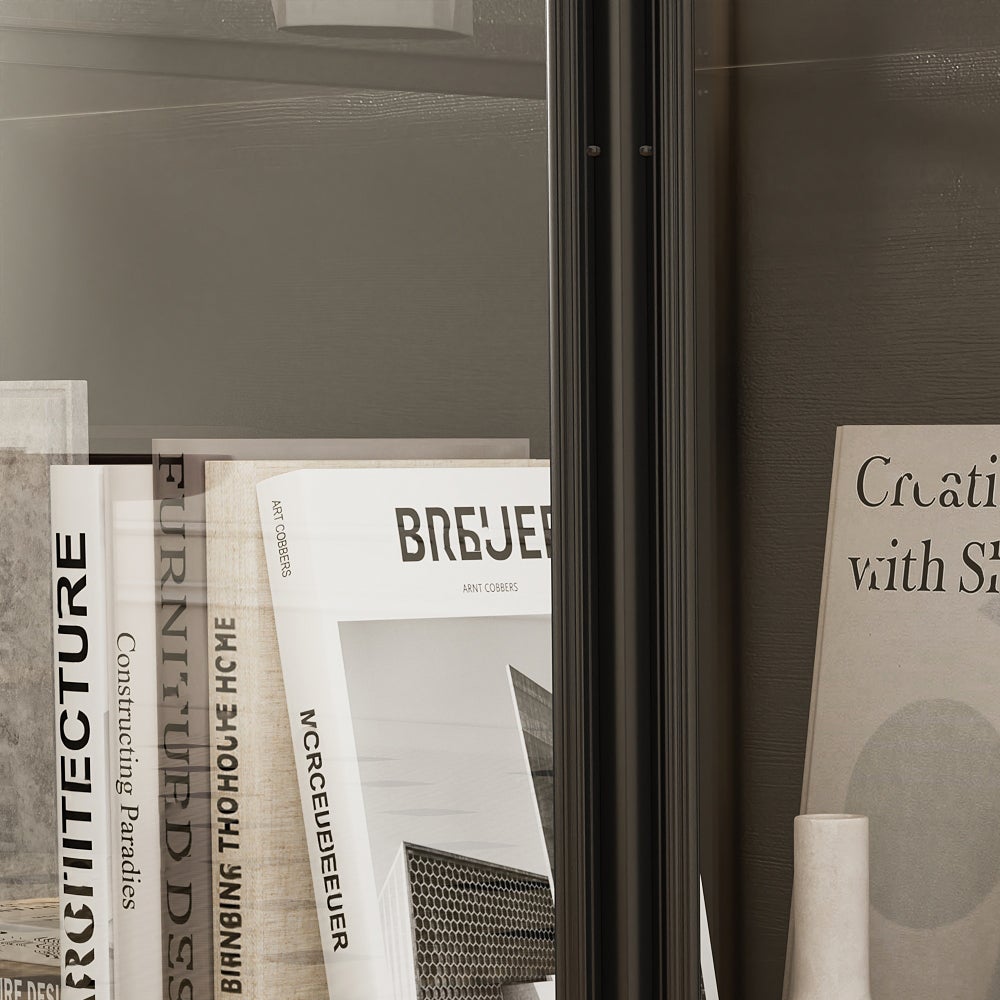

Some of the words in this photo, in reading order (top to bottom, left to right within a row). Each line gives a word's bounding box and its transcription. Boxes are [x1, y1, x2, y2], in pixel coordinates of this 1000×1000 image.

[271, 500, 284, 521] ART
[275, 524, 292, 578] COBBERS
[848, 538, 946, 592] with
[463, 583, 482, 593] ARNT
[484, 582, 519, 593] COBBERS
[116, 632, 139, 796] Constructing
[120, 804, 142, 911] Paradies
